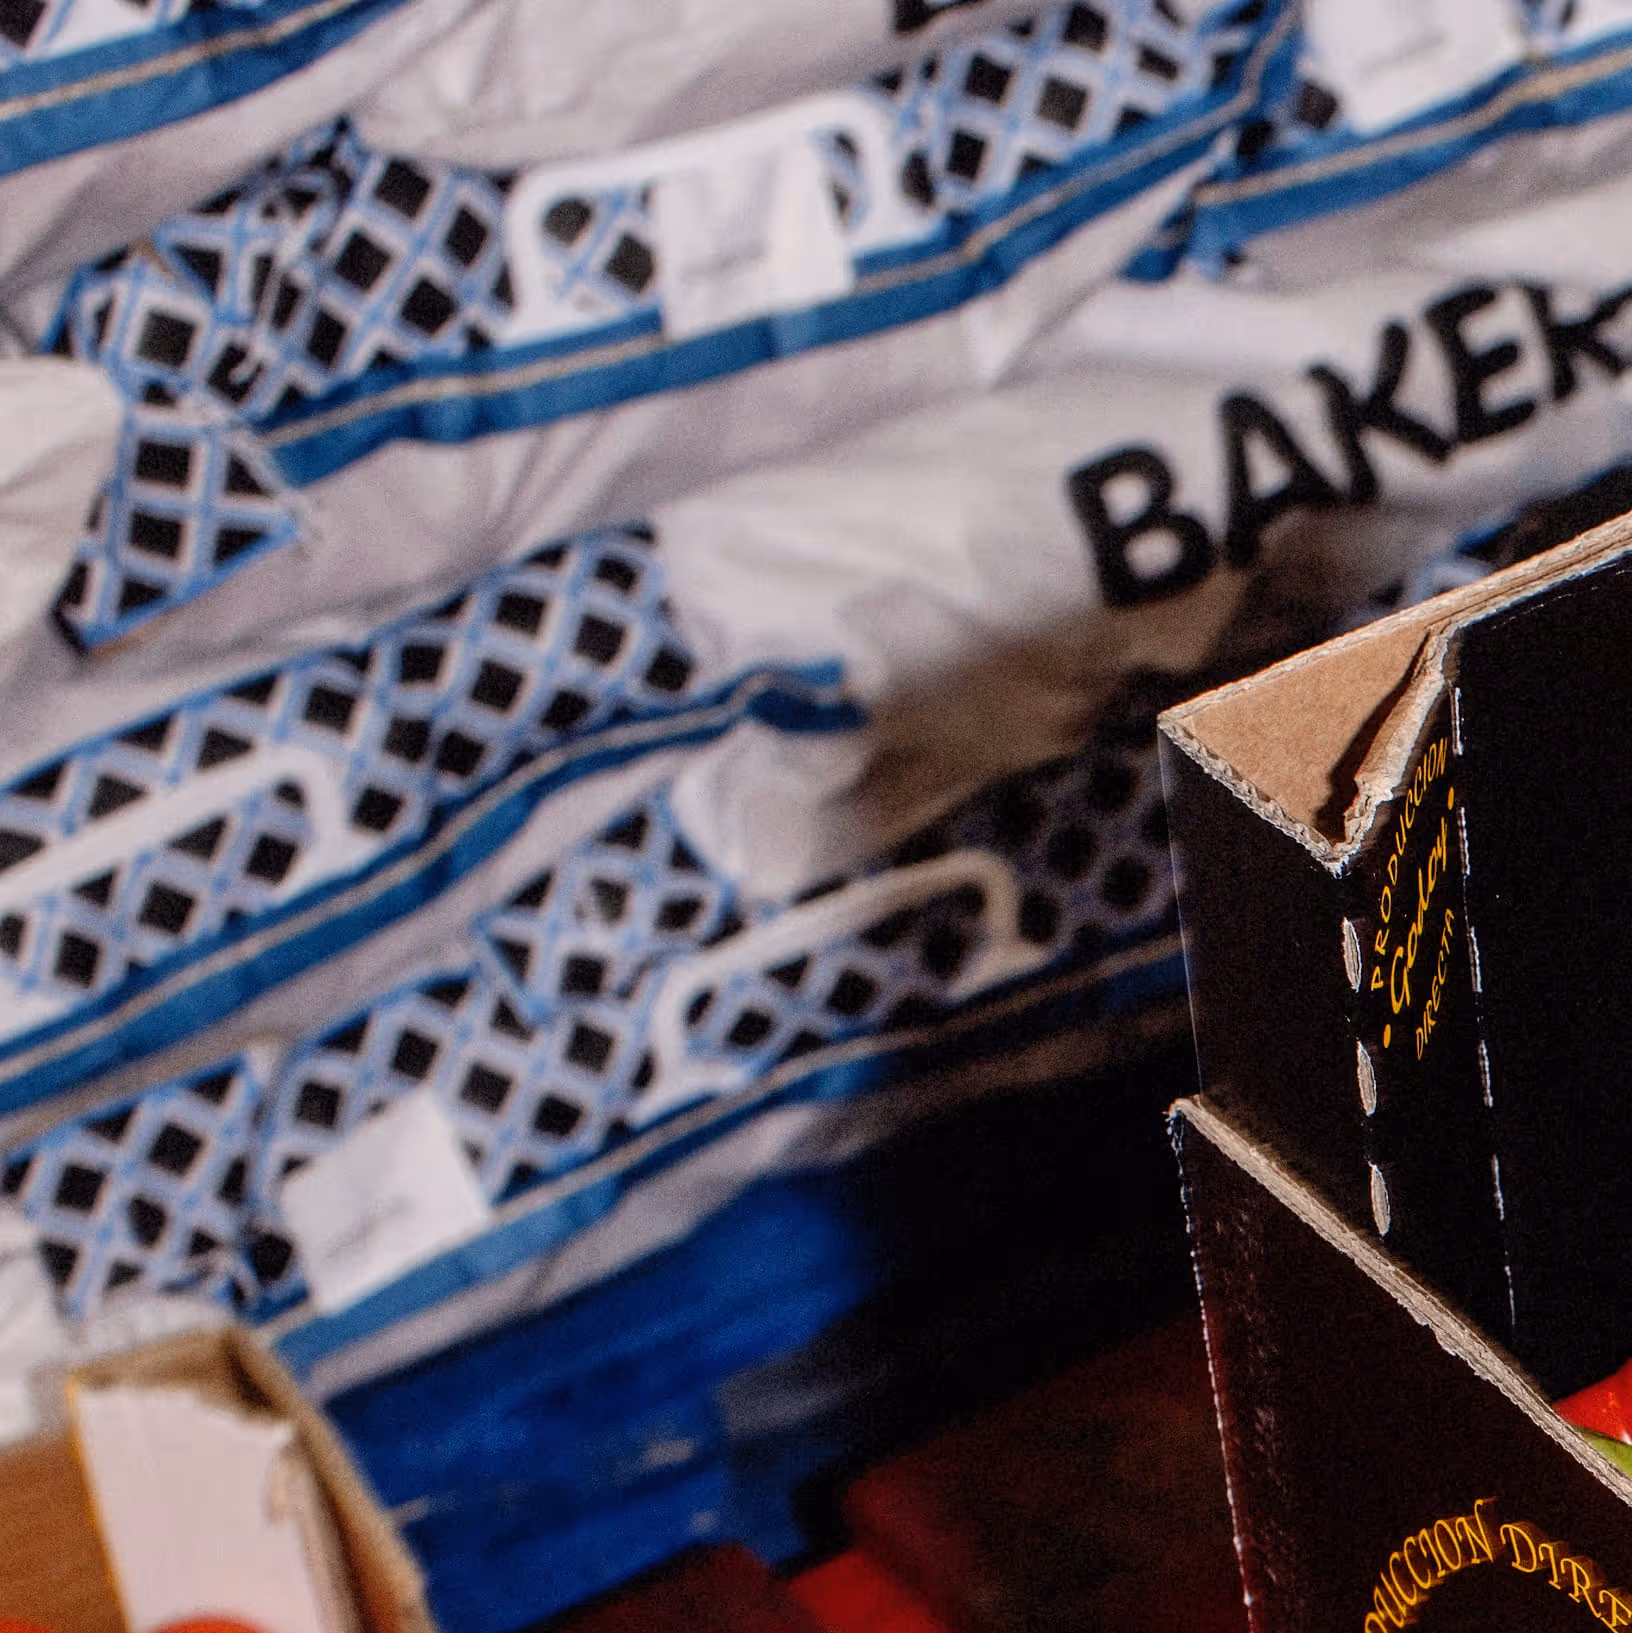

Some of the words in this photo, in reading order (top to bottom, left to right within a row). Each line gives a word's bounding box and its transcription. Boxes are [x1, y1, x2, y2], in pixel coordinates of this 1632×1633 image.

[1371, 738, 1447, 991] PRODUCCION
[1391, 816, 1447, 1014] Godoy
[1416, 909, 1454, 1060] DIRECTA
